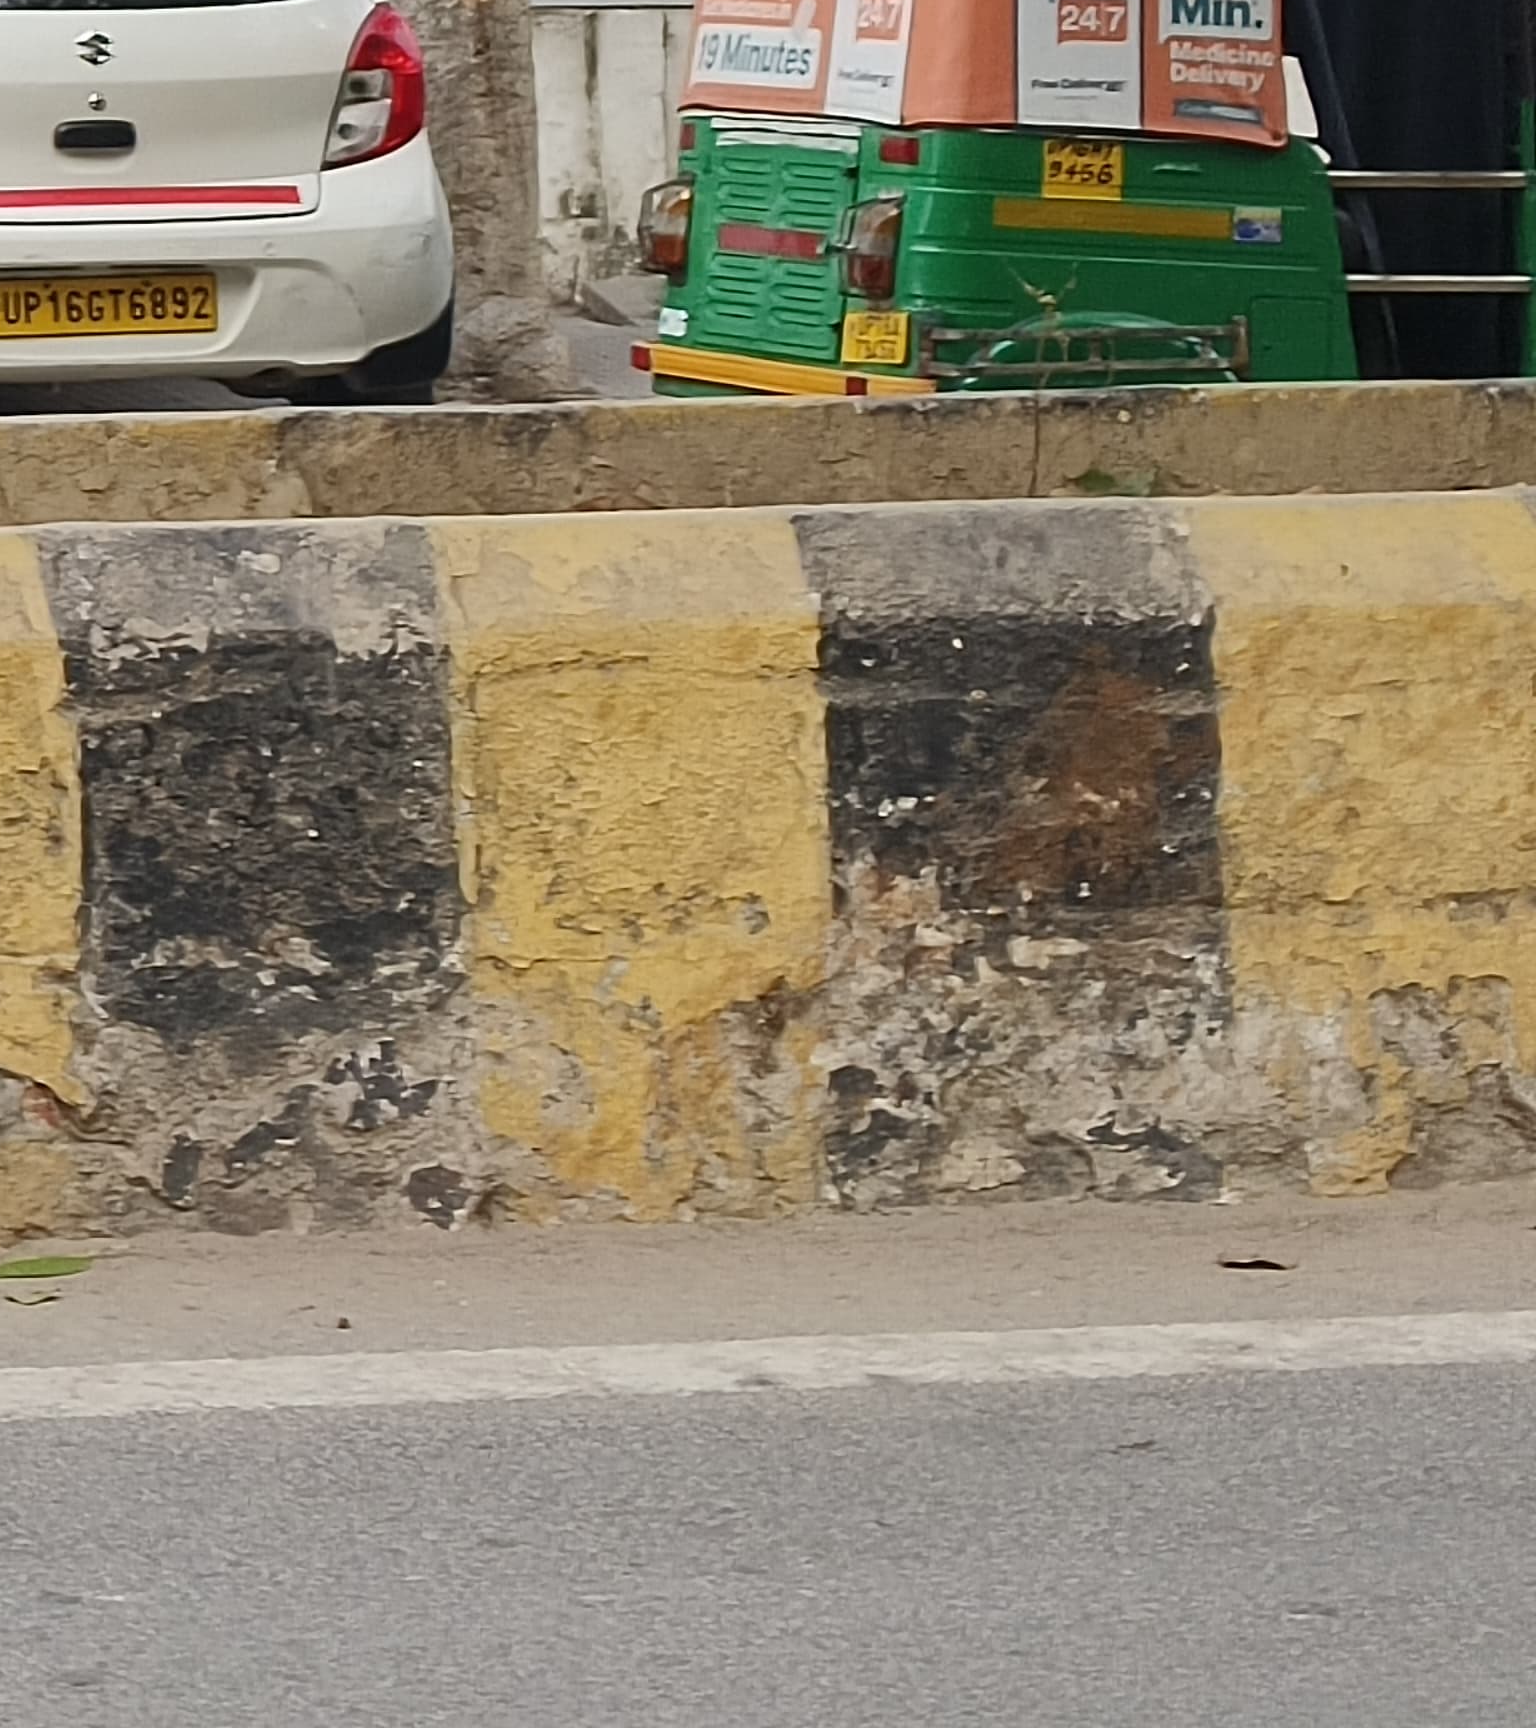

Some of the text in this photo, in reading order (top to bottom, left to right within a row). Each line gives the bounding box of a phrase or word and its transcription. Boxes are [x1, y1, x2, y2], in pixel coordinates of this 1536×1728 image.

[697, 33, 719, 71] 19
[1169, 40, 1274, 67] Medicine
[1170, 61, 1265, 94] Delivery
[3, 284, 211, 325] UP16GT6892
